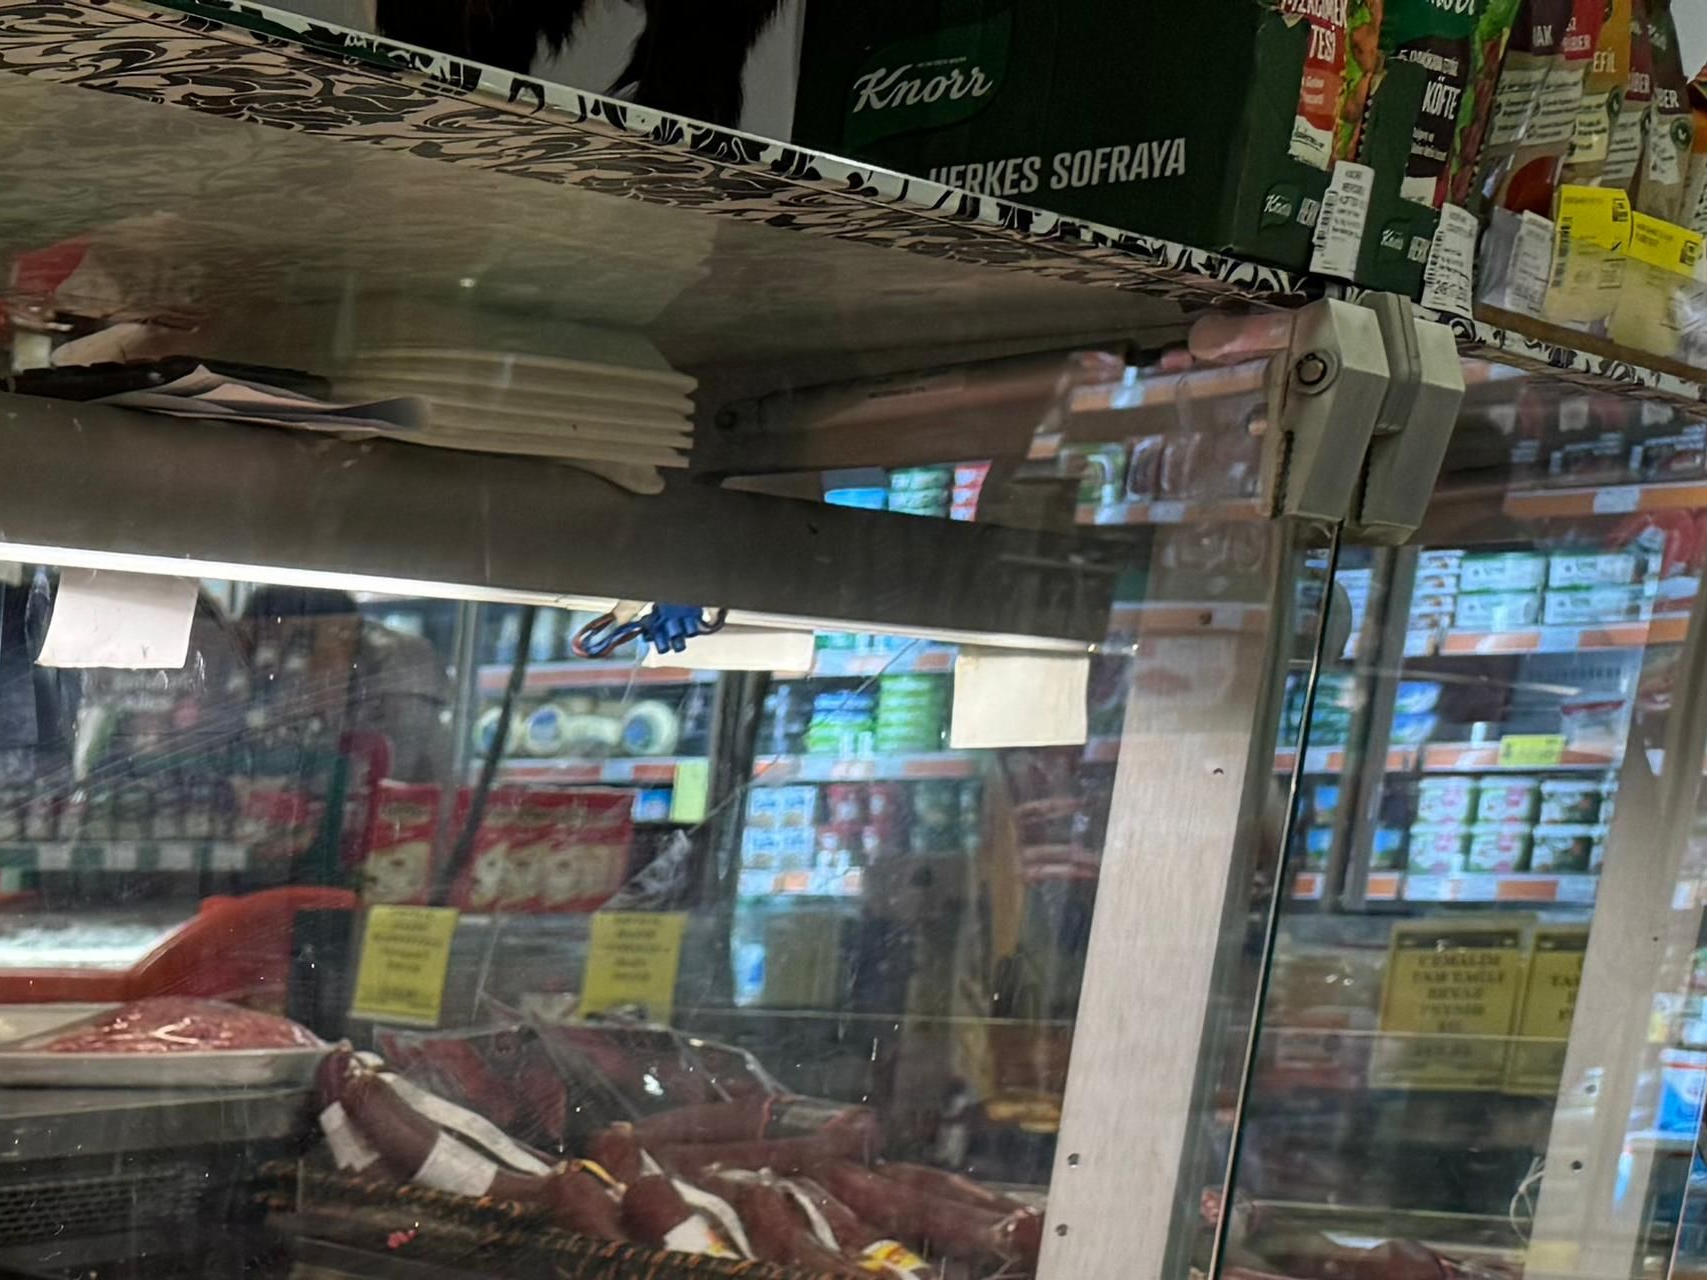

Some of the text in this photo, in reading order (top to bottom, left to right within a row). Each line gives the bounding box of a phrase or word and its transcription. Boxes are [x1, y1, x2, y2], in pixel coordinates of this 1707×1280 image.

[852, 64, 993, 113] Knorr
[1422, 76, 1461, 120] KÖFTE
[1050, 137, 1186, 190] SOFRAYA
